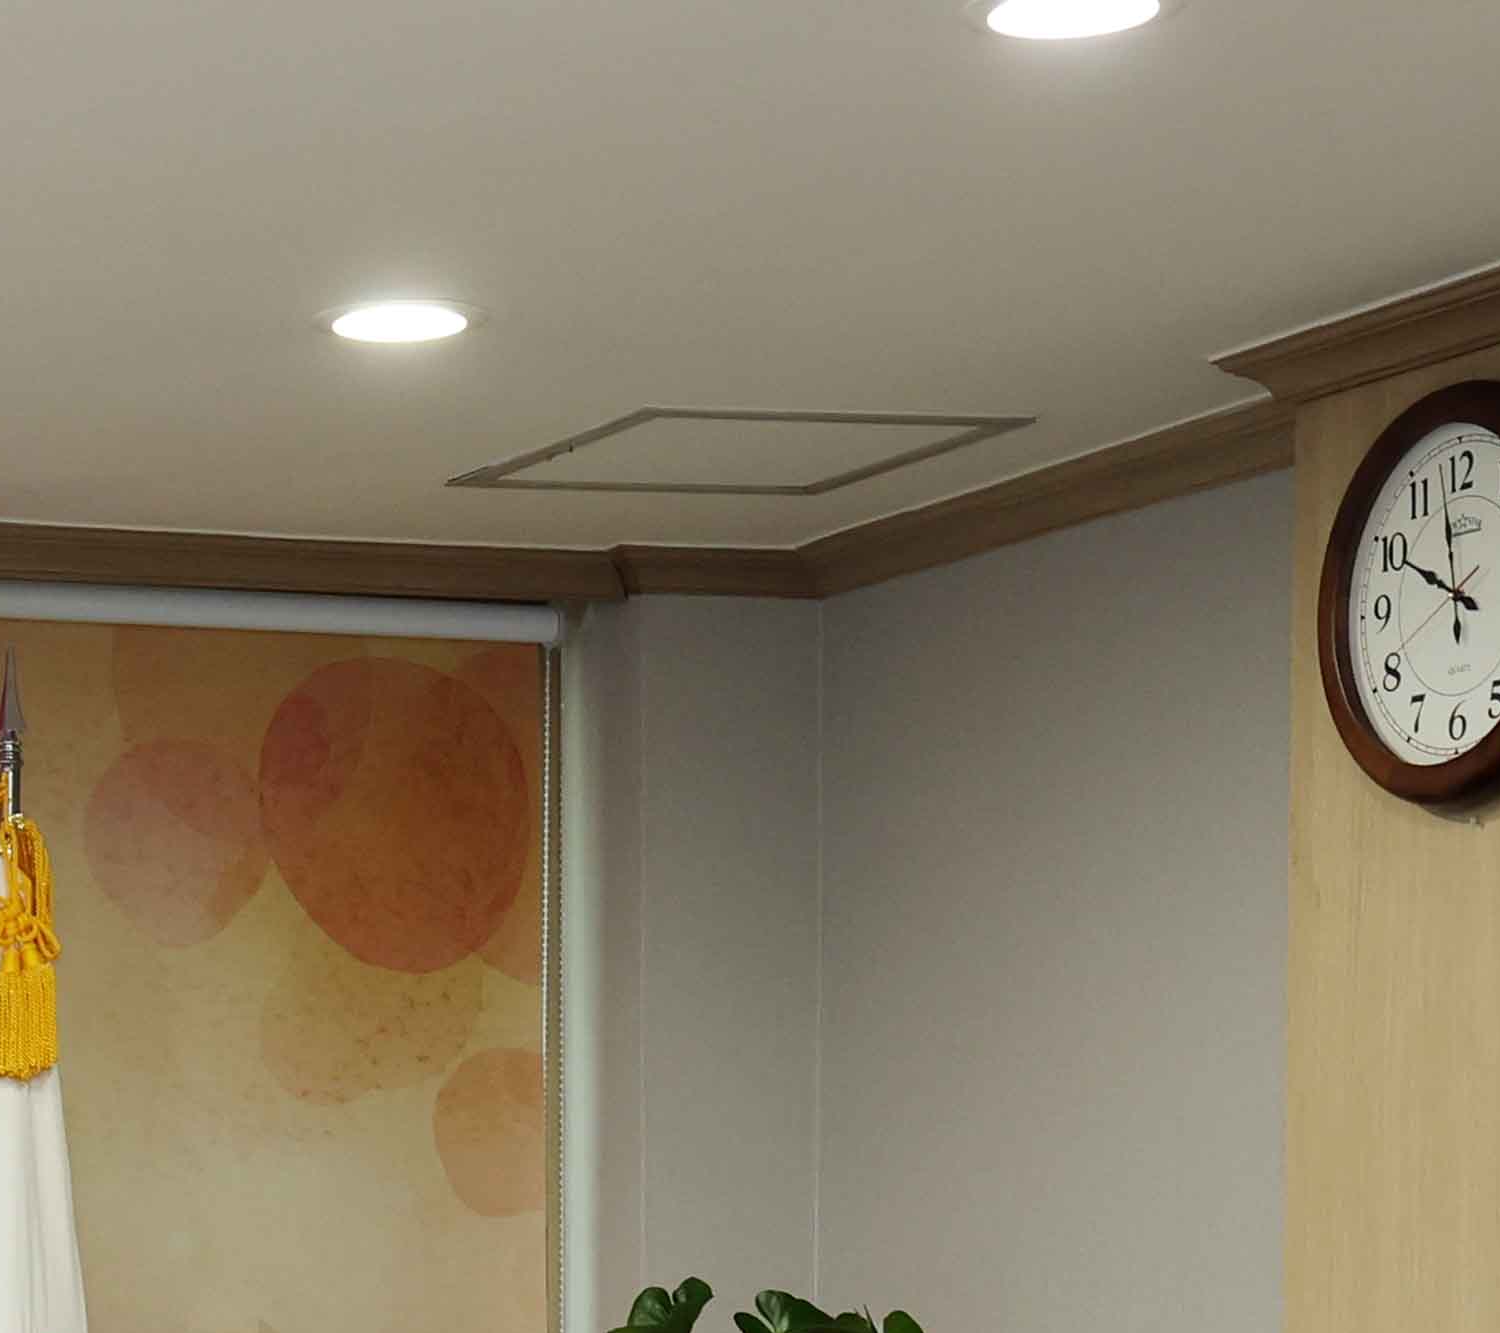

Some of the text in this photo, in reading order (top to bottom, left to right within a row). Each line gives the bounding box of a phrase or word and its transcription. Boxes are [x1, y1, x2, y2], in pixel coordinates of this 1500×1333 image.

[1449, 451, 1474, 492] 12
[1409, 478, 1430, 519] 11
[1381, 532, 1407, 572] 10
[1374, 595, 1391, 632] 9
[1383, 652, 1400, 692] 8
[1410, 694, 1425, 733] 7
[1448, 701, 1466, 741] 6
